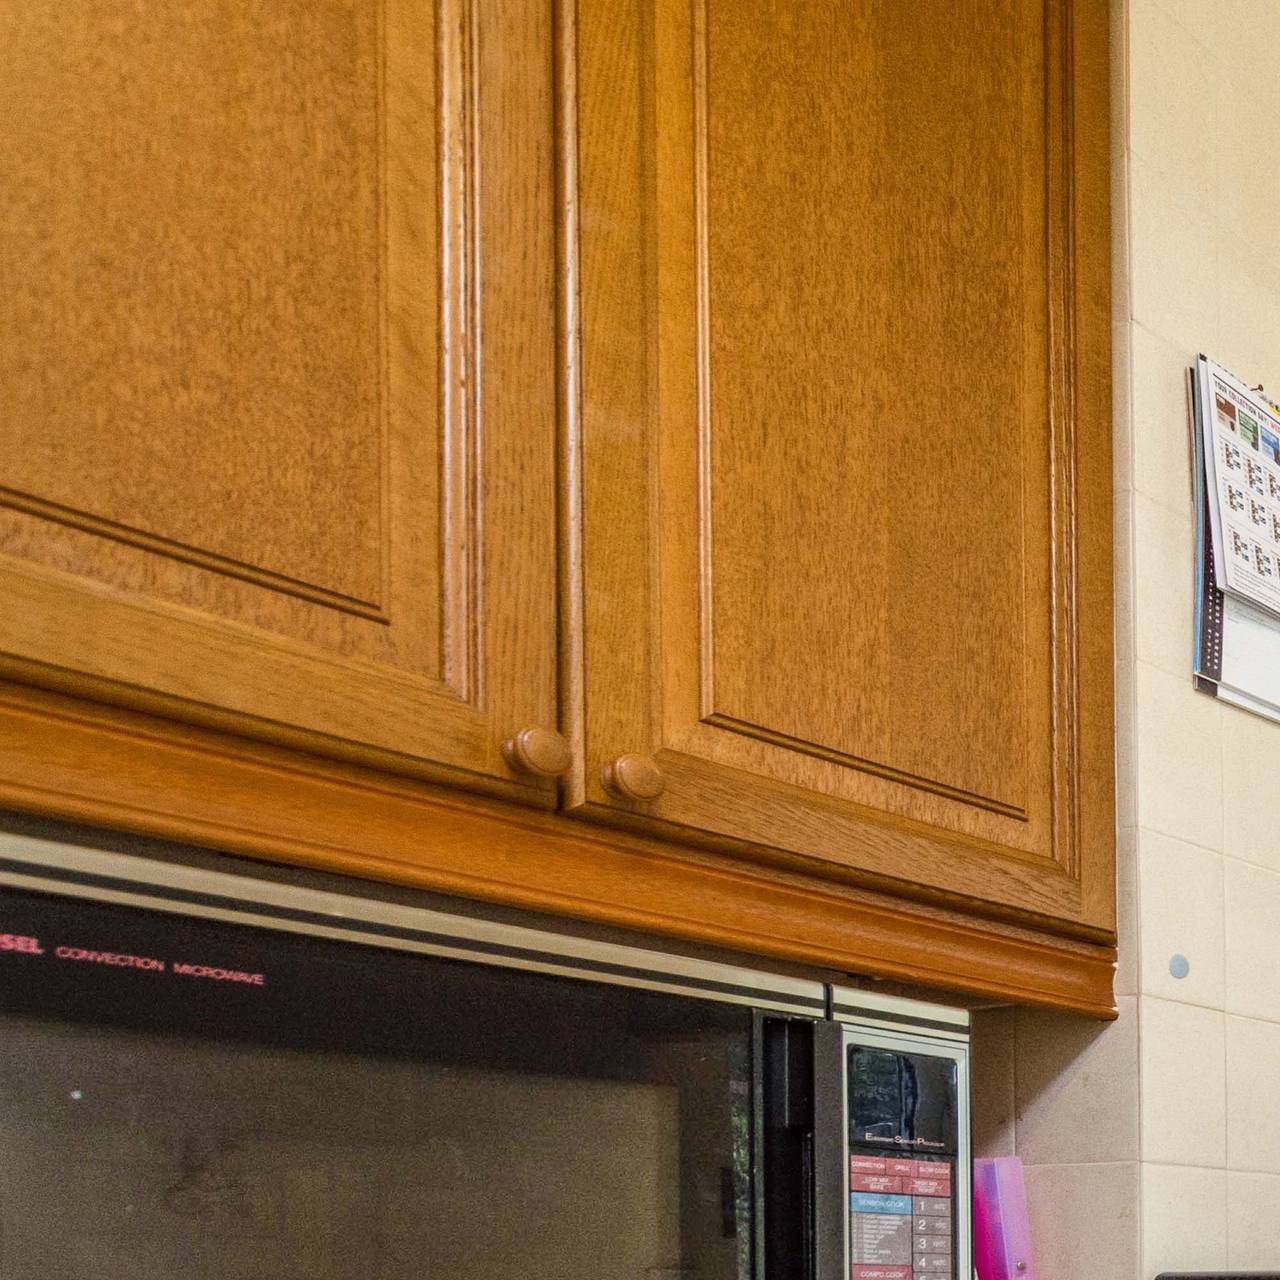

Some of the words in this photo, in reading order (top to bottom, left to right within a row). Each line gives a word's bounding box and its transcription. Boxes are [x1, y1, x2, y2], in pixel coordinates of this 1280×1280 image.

[55, 946, 164, 972] CONVECTION
[173, 962, 264, 985] MICROWAVE
[919, 1201, 925, 1211] 1
[919, 1220, 926, 1230] 2
[919, 1238, 927, 1249] 3
[919, 1257, 926, 1267] 4
